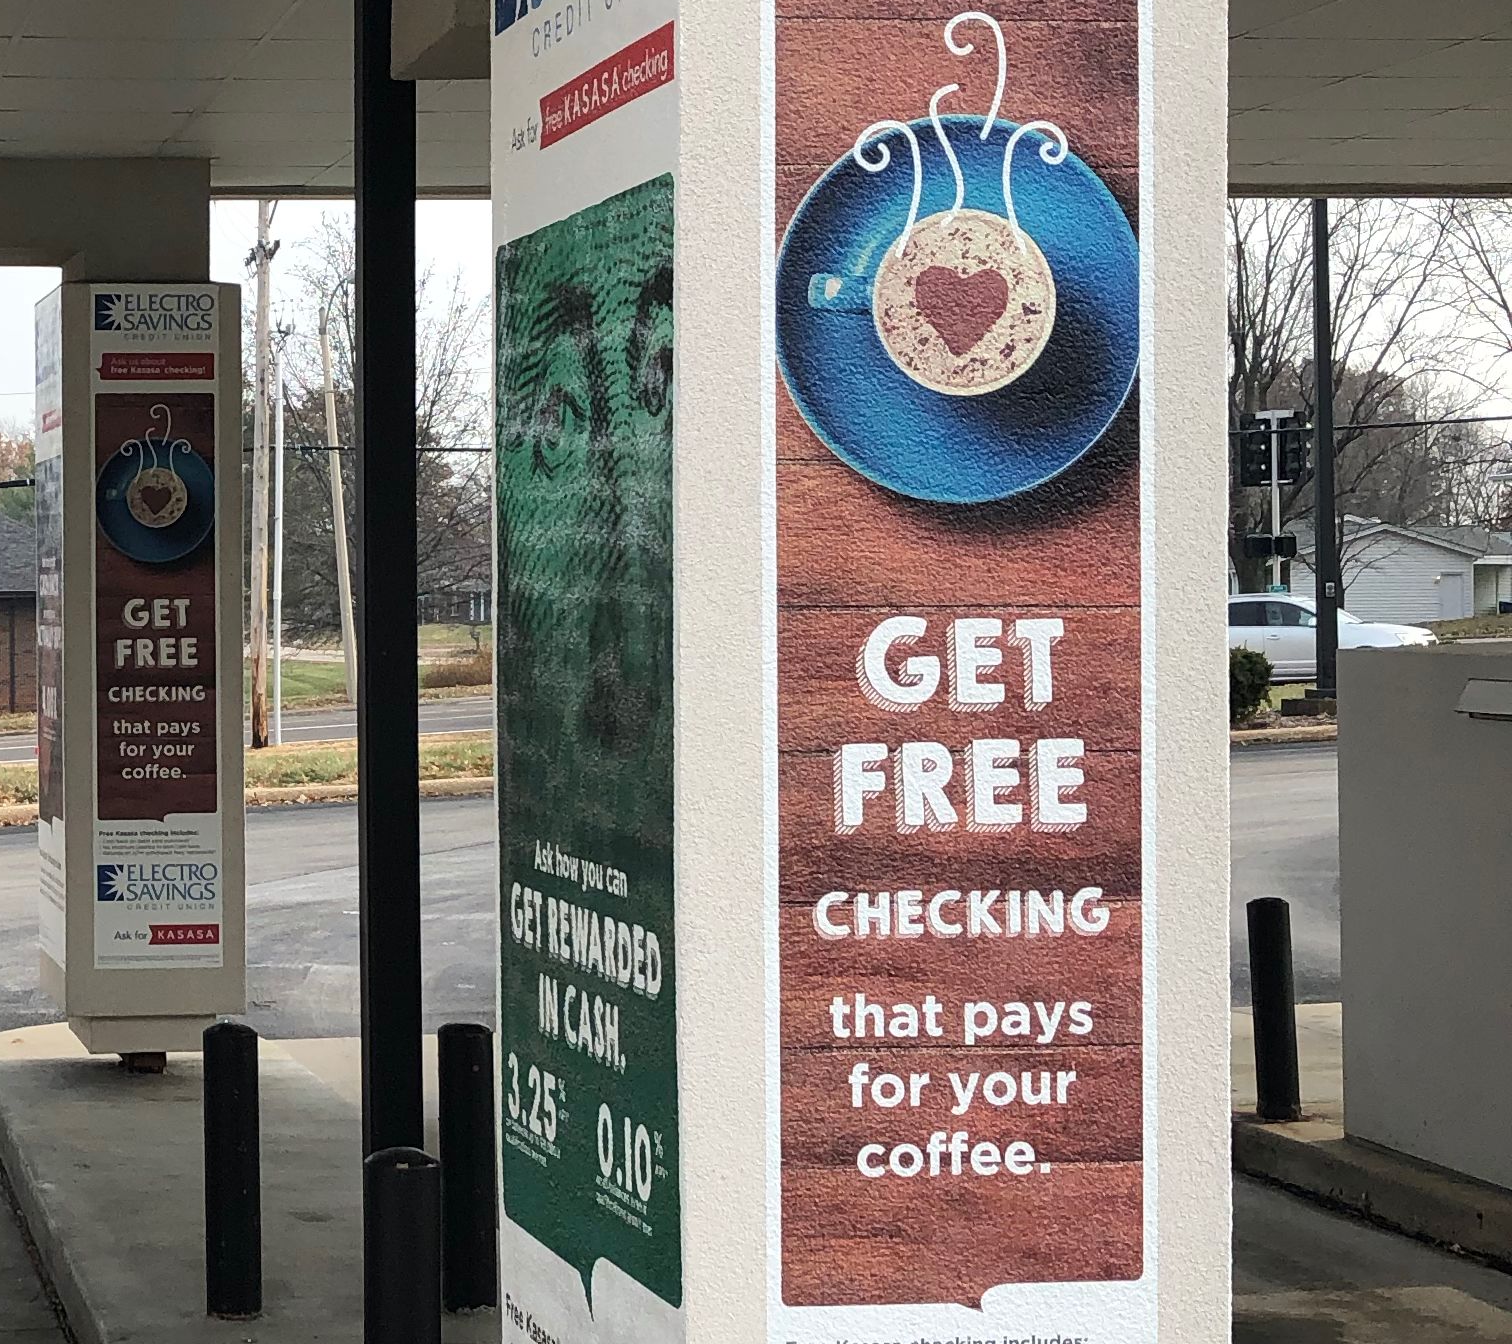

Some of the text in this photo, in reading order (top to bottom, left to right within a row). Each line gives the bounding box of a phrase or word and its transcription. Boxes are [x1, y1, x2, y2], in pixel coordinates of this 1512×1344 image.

[545, 107, 563, 135] free
[563, 67, 621, 125] KASASA
[622, 47, 668, 91] checking
[125, 293, 215, 311] ELECTRO
[124, 313, 213, 331] SAVINGS
[164, 366, 206, 376] checking!
[122, 598, 190, 629] GET
[114, 637, 198, 668] FREE
[857, 616, 1065, 713] GET
[108, 685, 206, 703] CHECKING
[113, 719, 201, 737] that pays
[119, 741, 195, 759] for your
[122, 763, 187, 779] coffee.
[833, 738, 1088, 835] FREE
[127, 863, 218, 882] ELECTRO
[534, 839, 628, 898] Ask how you can
[126, 882, 216, 901] SAVINGS
[813, 887, 1111, 939] CHECKING
[114, 928, 215, 940] Ask for KASASA
[510, 882, 662, 1000] GET REWARDED
[539, 973, 627, 1075] IN CASH.
[828, 993, 1094, 1044] that pays
[848, 1064, 1077, 1115] for your
[856, 1132, 1051, 1179] coffee.
[506, 1292, 524, 1330] Free
